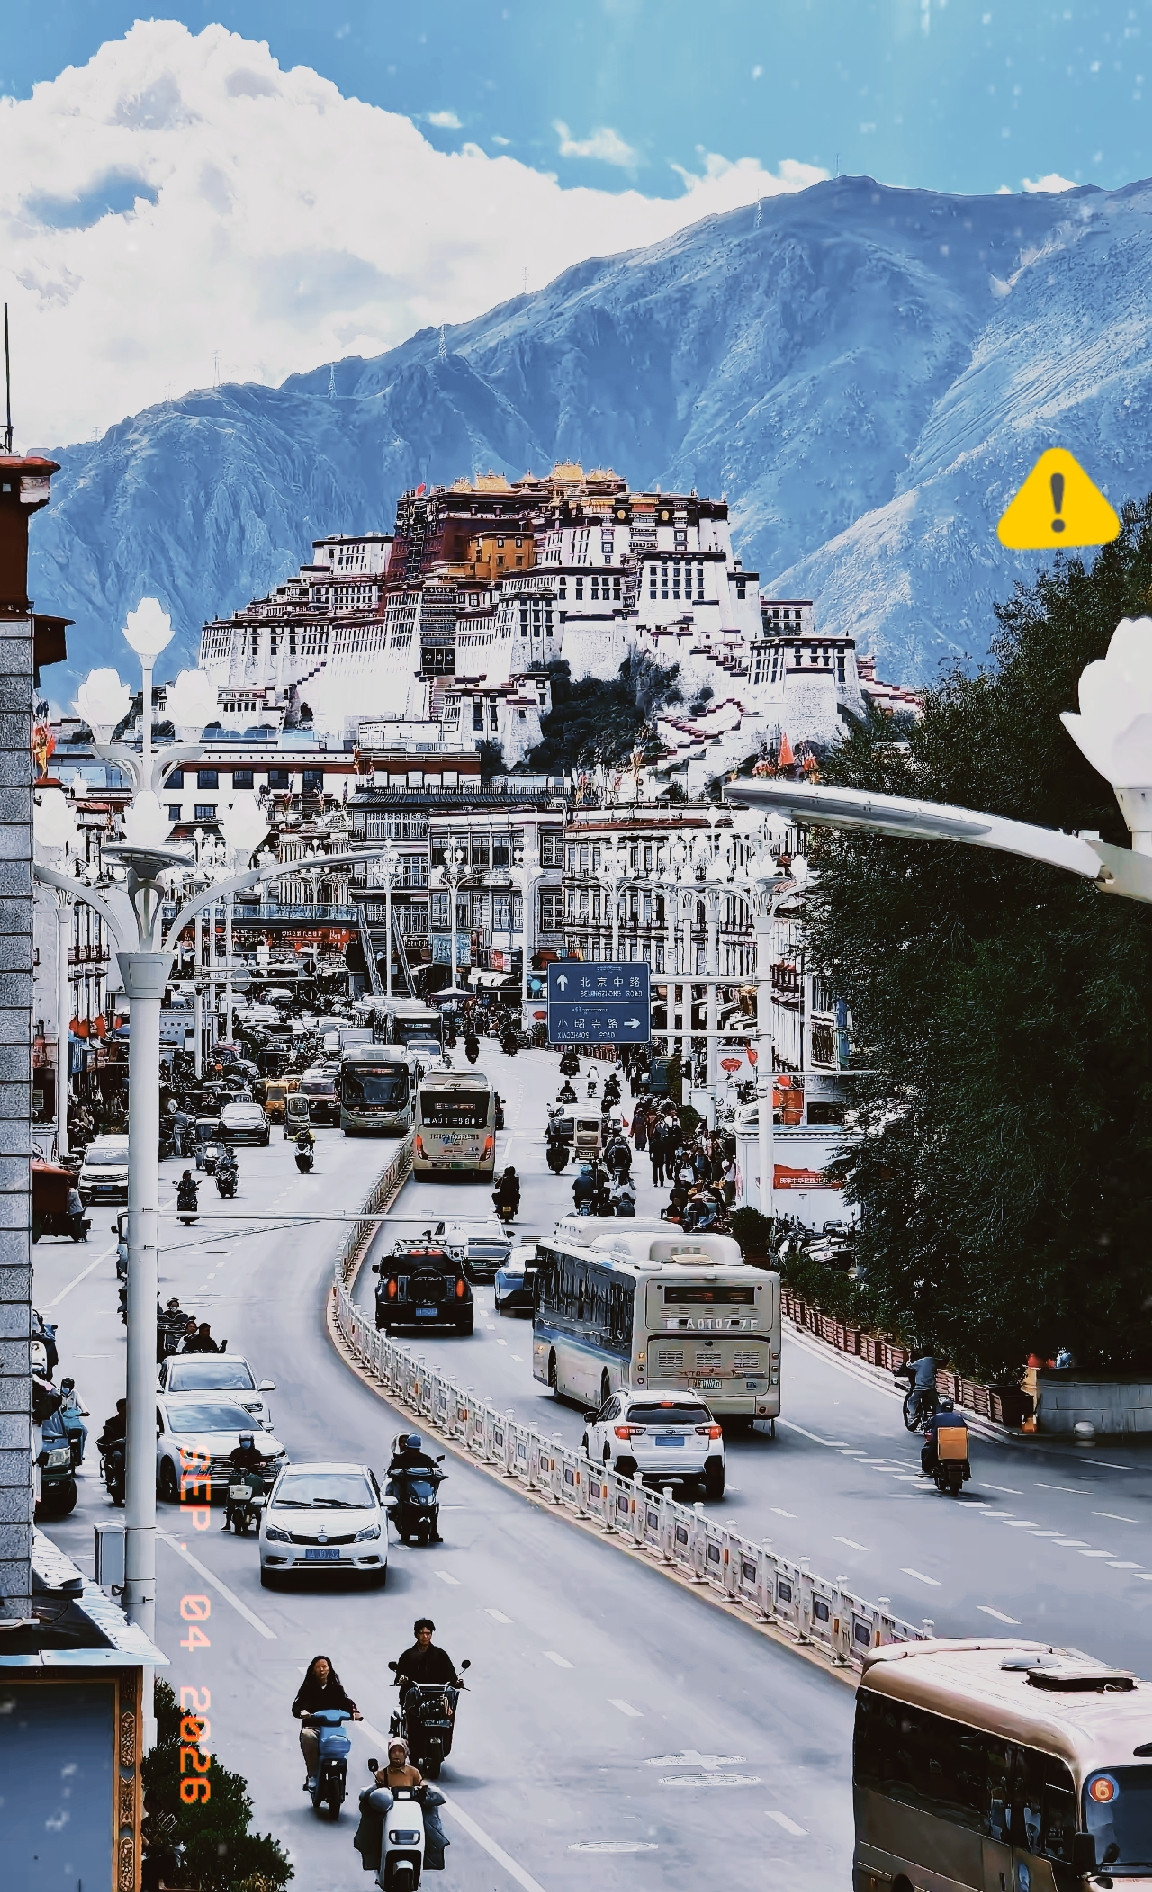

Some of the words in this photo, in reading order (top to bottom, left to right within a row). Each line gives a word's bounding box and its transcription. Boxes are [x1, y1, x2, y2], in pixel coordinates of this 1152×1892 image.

[580, 976, 640, 987] 北京中路
[1094, 1780, 1110, 1799] 6
